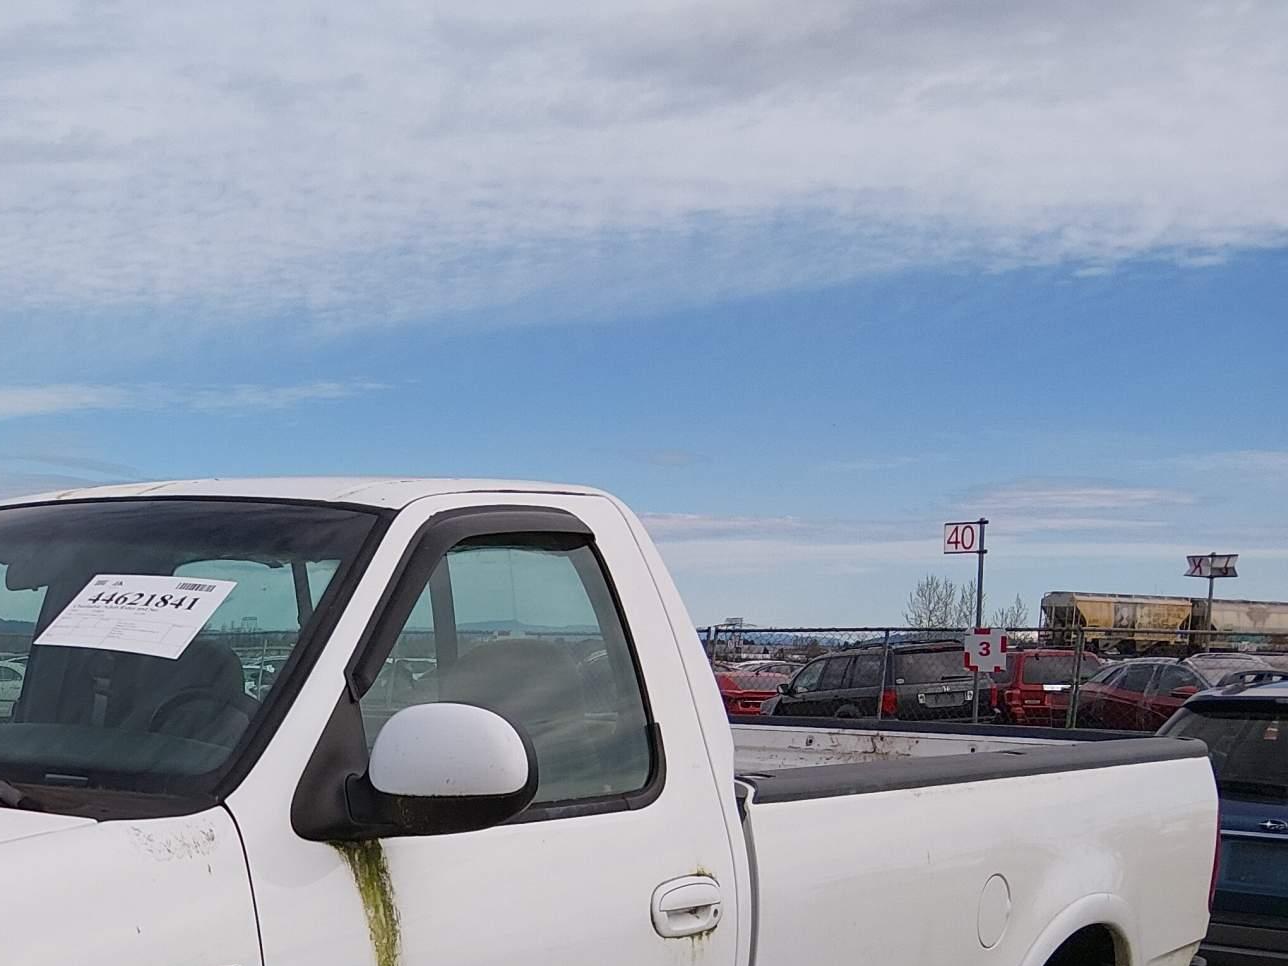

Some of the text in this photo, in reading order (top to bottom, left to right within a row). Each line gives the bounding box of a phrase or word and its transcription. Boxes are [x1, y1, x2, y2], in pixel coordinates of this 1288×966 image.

[947, 525, 974, 550] 40
[88, 591, 200, 611] 44621841
[978, 641, 991, 657] 3
